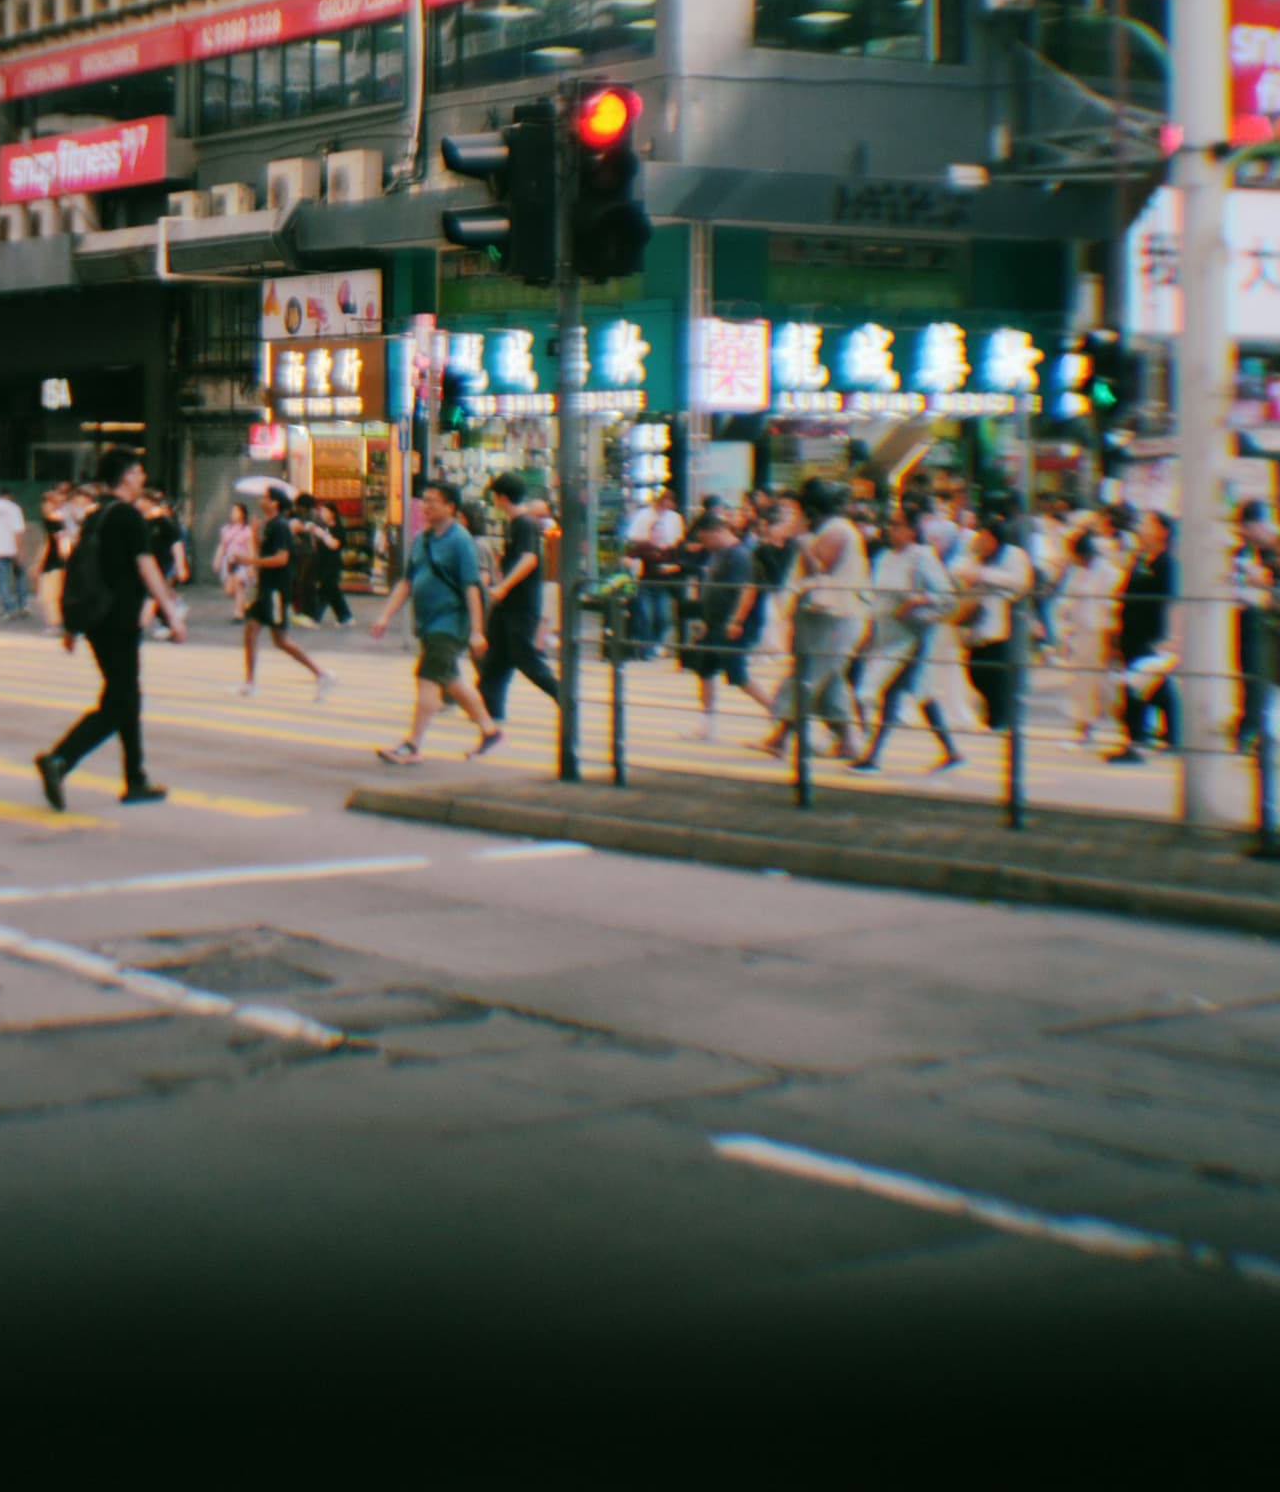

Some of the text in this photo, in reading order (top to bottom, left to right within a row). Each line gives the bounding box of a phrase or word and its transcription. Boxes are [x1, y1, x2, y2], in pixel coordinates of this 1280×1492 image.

[9, 151, 57, 196] snap
[58, 138, 121, 186] fitness
[777, 390, 843, 413] LUNG
